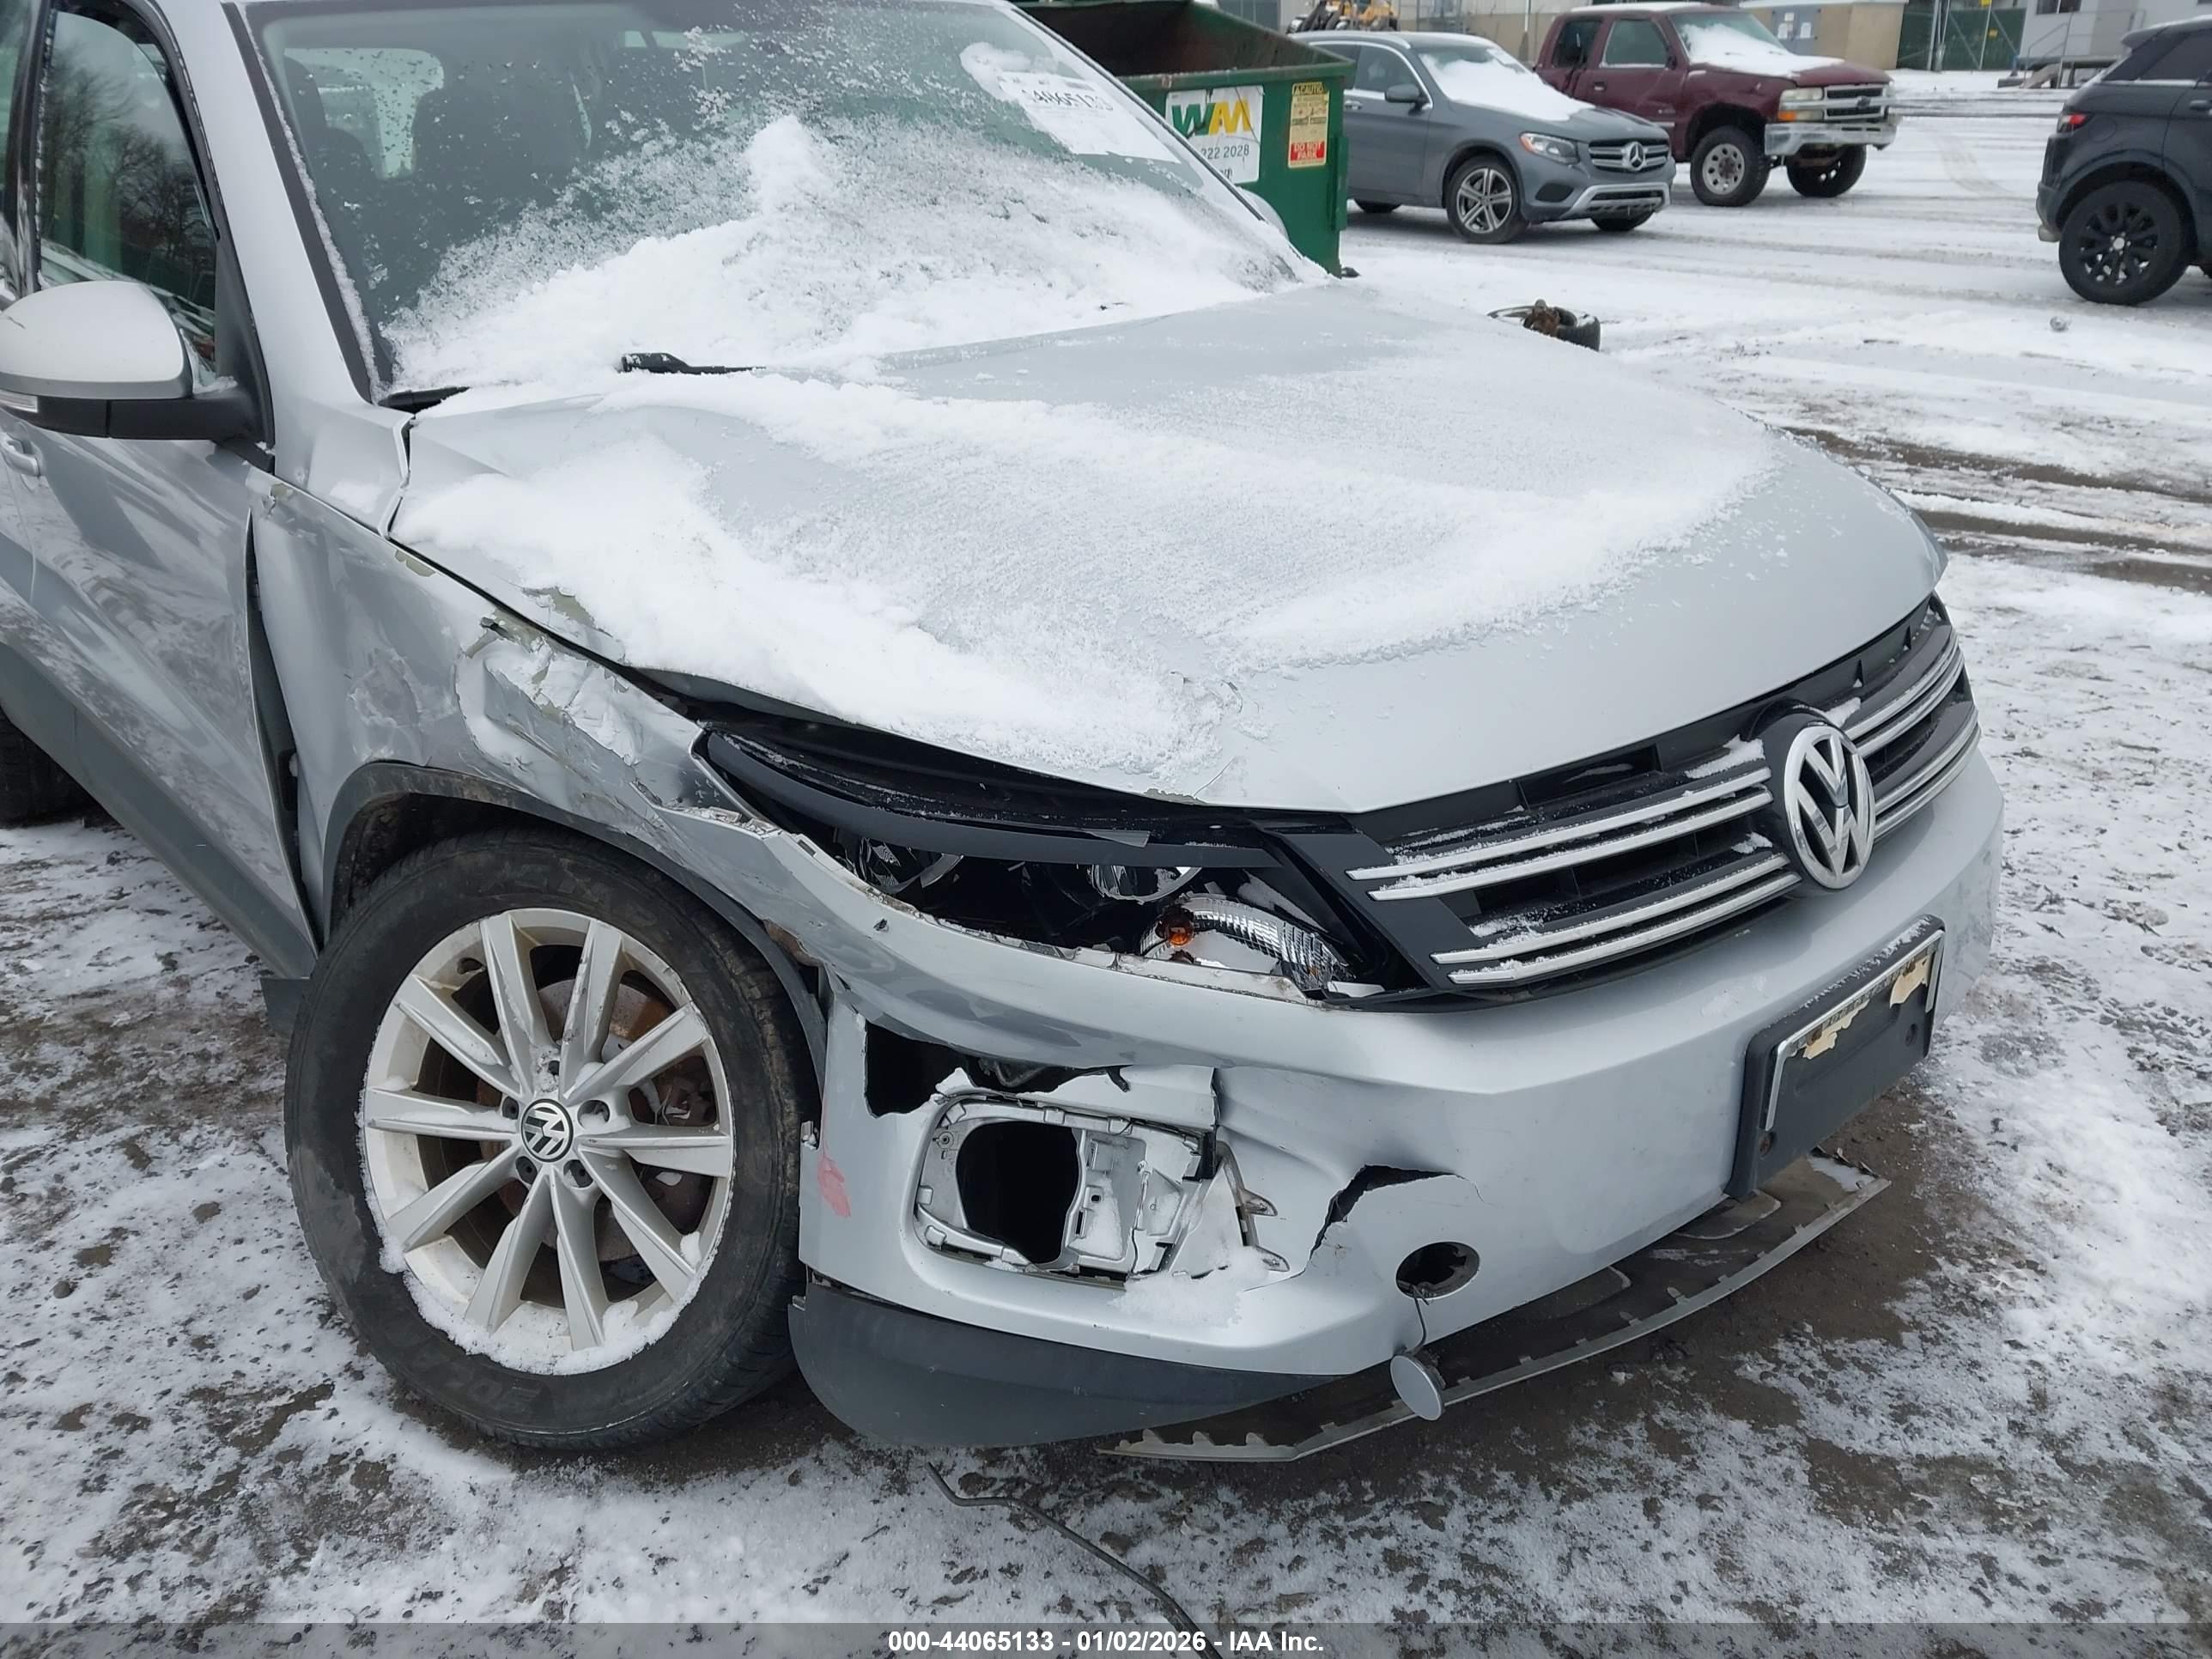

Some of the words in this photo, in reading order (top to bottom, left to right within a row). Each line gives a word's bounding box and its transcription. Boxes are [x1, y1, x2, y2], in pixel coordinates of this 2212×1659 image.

[1171, 100, 1251, 138] WM
[1224, 143, 1249, 158] 2028
[1294, 143, 1305, 152] DO
[1307, 142, 1322, 151] NOT
